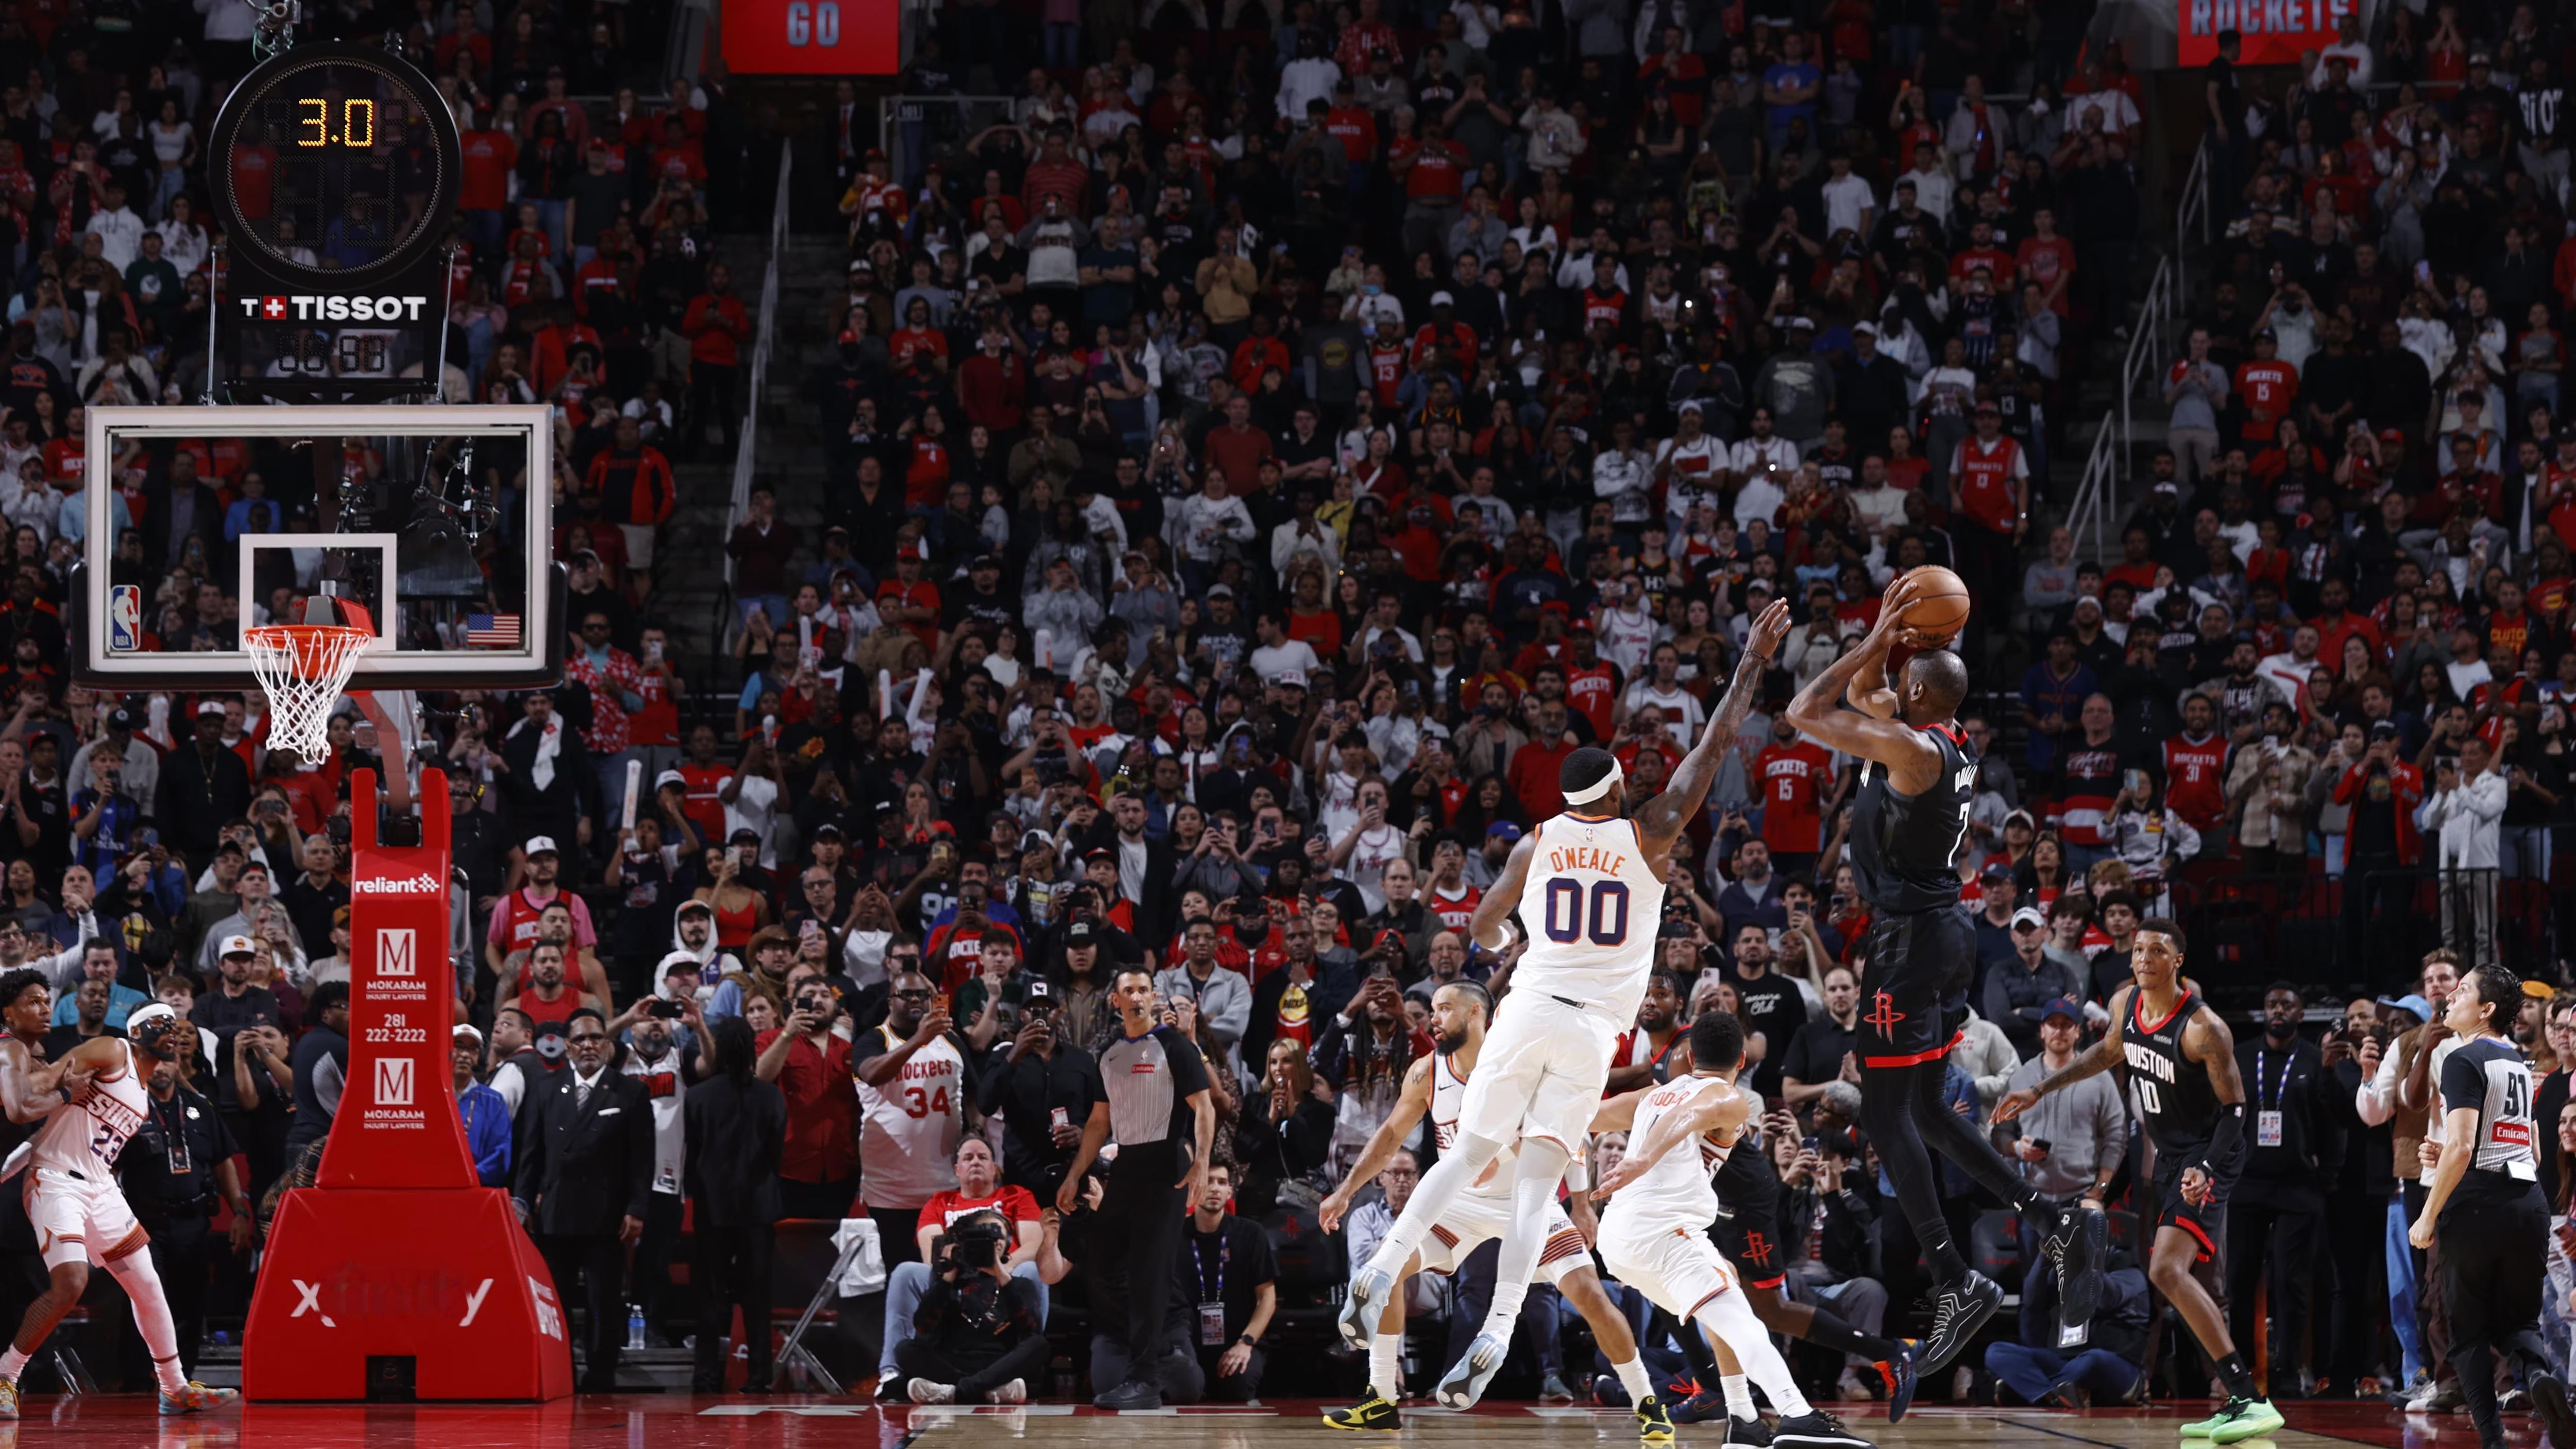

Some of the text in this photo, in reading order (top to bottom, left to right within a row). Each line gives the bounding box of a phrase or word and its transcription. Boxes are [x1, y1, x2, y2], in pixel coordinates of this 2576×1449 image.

[787, 1, 840, 47] GO
[2191, 0, 2350, 36] ROCKETS
[298, 99, 373, 147] 3.0
[292, 296, 426, 321] TISSOT
[114, 635, 130, 646] NBA
[1586, 690, 1598, 713] 7
[2173, 752, 2216, 766] ROCKETS
[2186, 764, 2200, 782] 31
[1778, 780, 1793, 801] 15
[1947, 802, 1971, 867] 7
[1550, 847, 1626, 878] O'NEALE
[355, 874, 418, 894] reliant
[1546, 877, 1630, 947] 00
[366, 981, 427, 991] MOKARAM
[384, 1014, 405, 1028] 281
[365, 1029, 427, 1042] 222-2222
[2124, 1041, 2175, 1085] HOUSTON
[905, 1086, 951, 1119] 34
[2138, 1076, 2161, 1115] 10
[2504, 1071, 2528, 1118] 91
[87, 1092, 144, 1137] SUNS
[364, 1109, 425, 1120] MOKARAM
[90, 1125, 124, 1165] 23
[2496, 1126, 2529, 1142] Emirates
